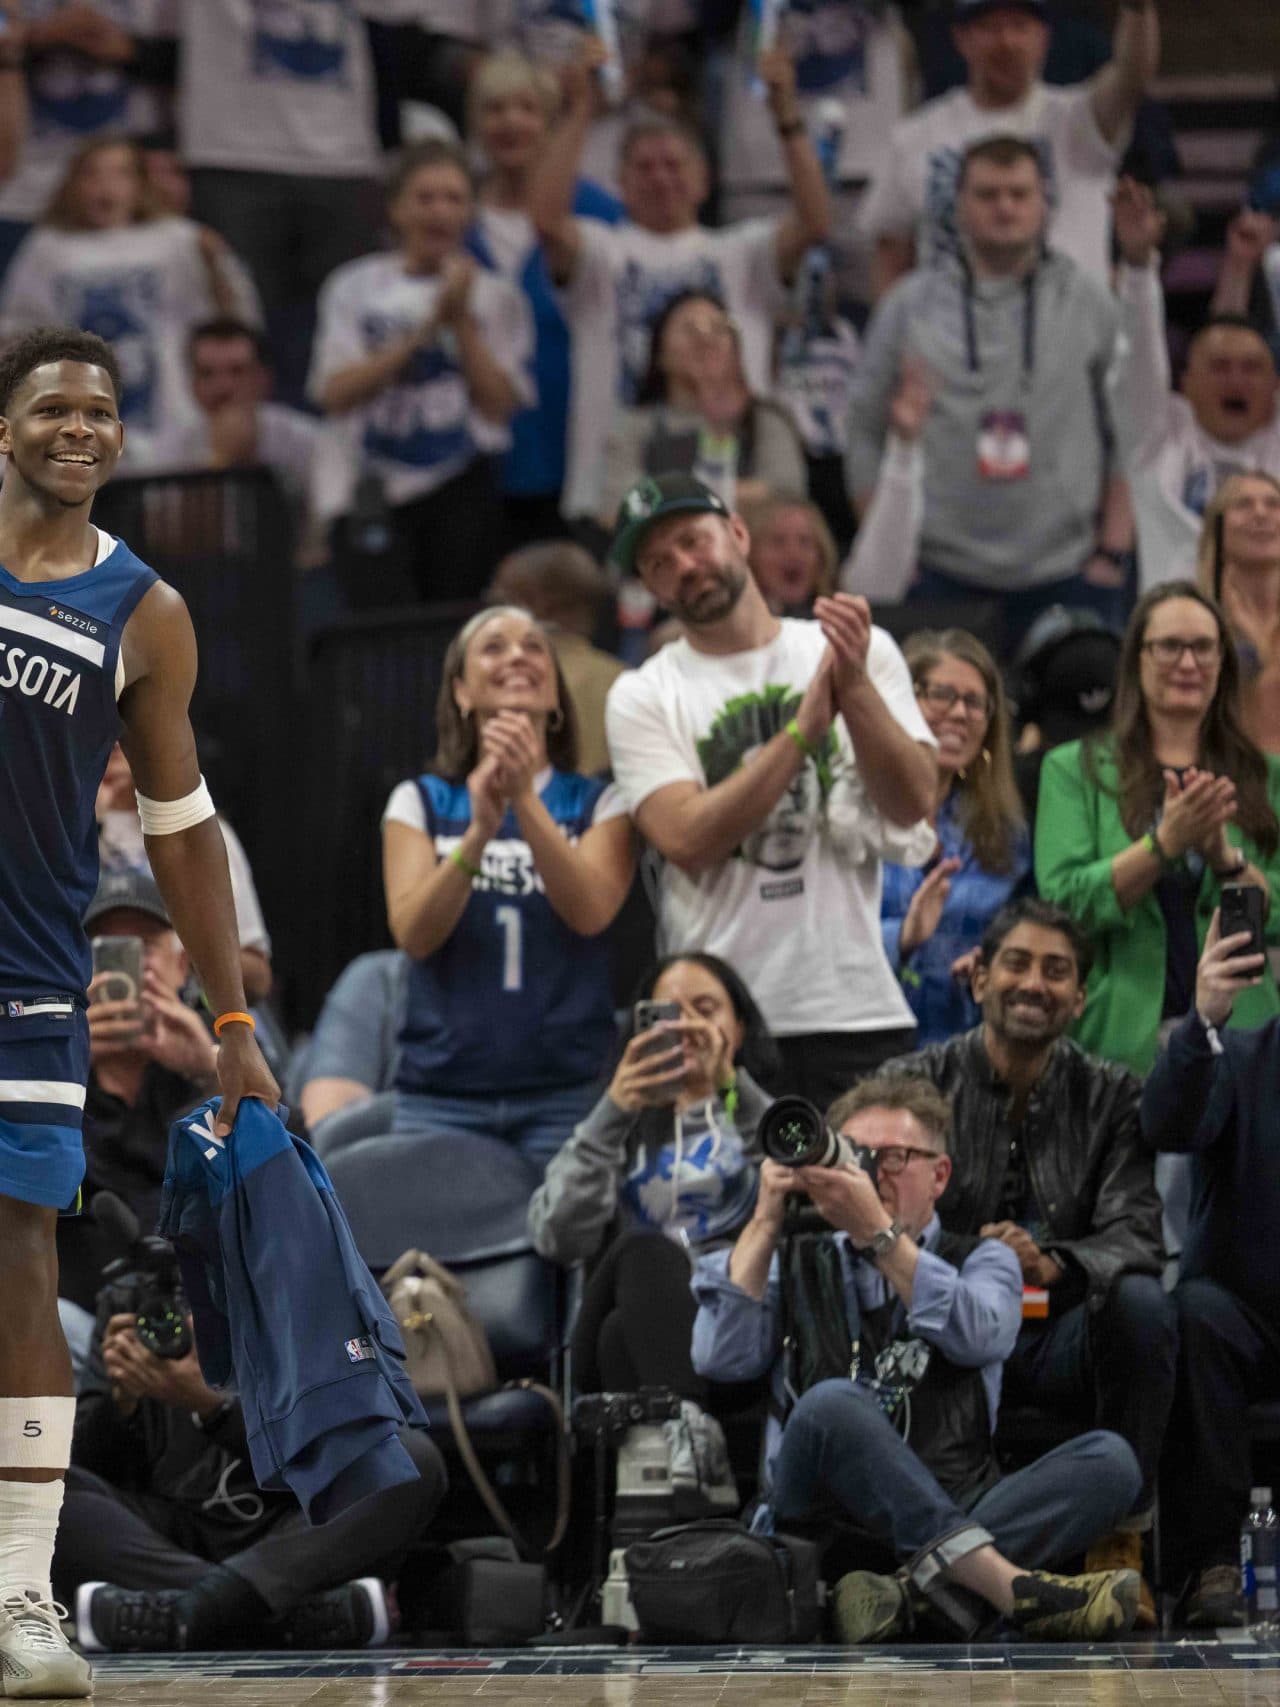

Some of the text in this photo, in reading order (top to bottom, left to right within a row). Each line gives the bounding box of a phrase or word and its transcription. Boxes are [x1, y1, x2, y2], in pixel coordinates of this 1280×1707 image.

[57, 610, 98, 635] sezzle
[496, 906, 522, 991] 1
[23, 1420, 41, 1437] 5
